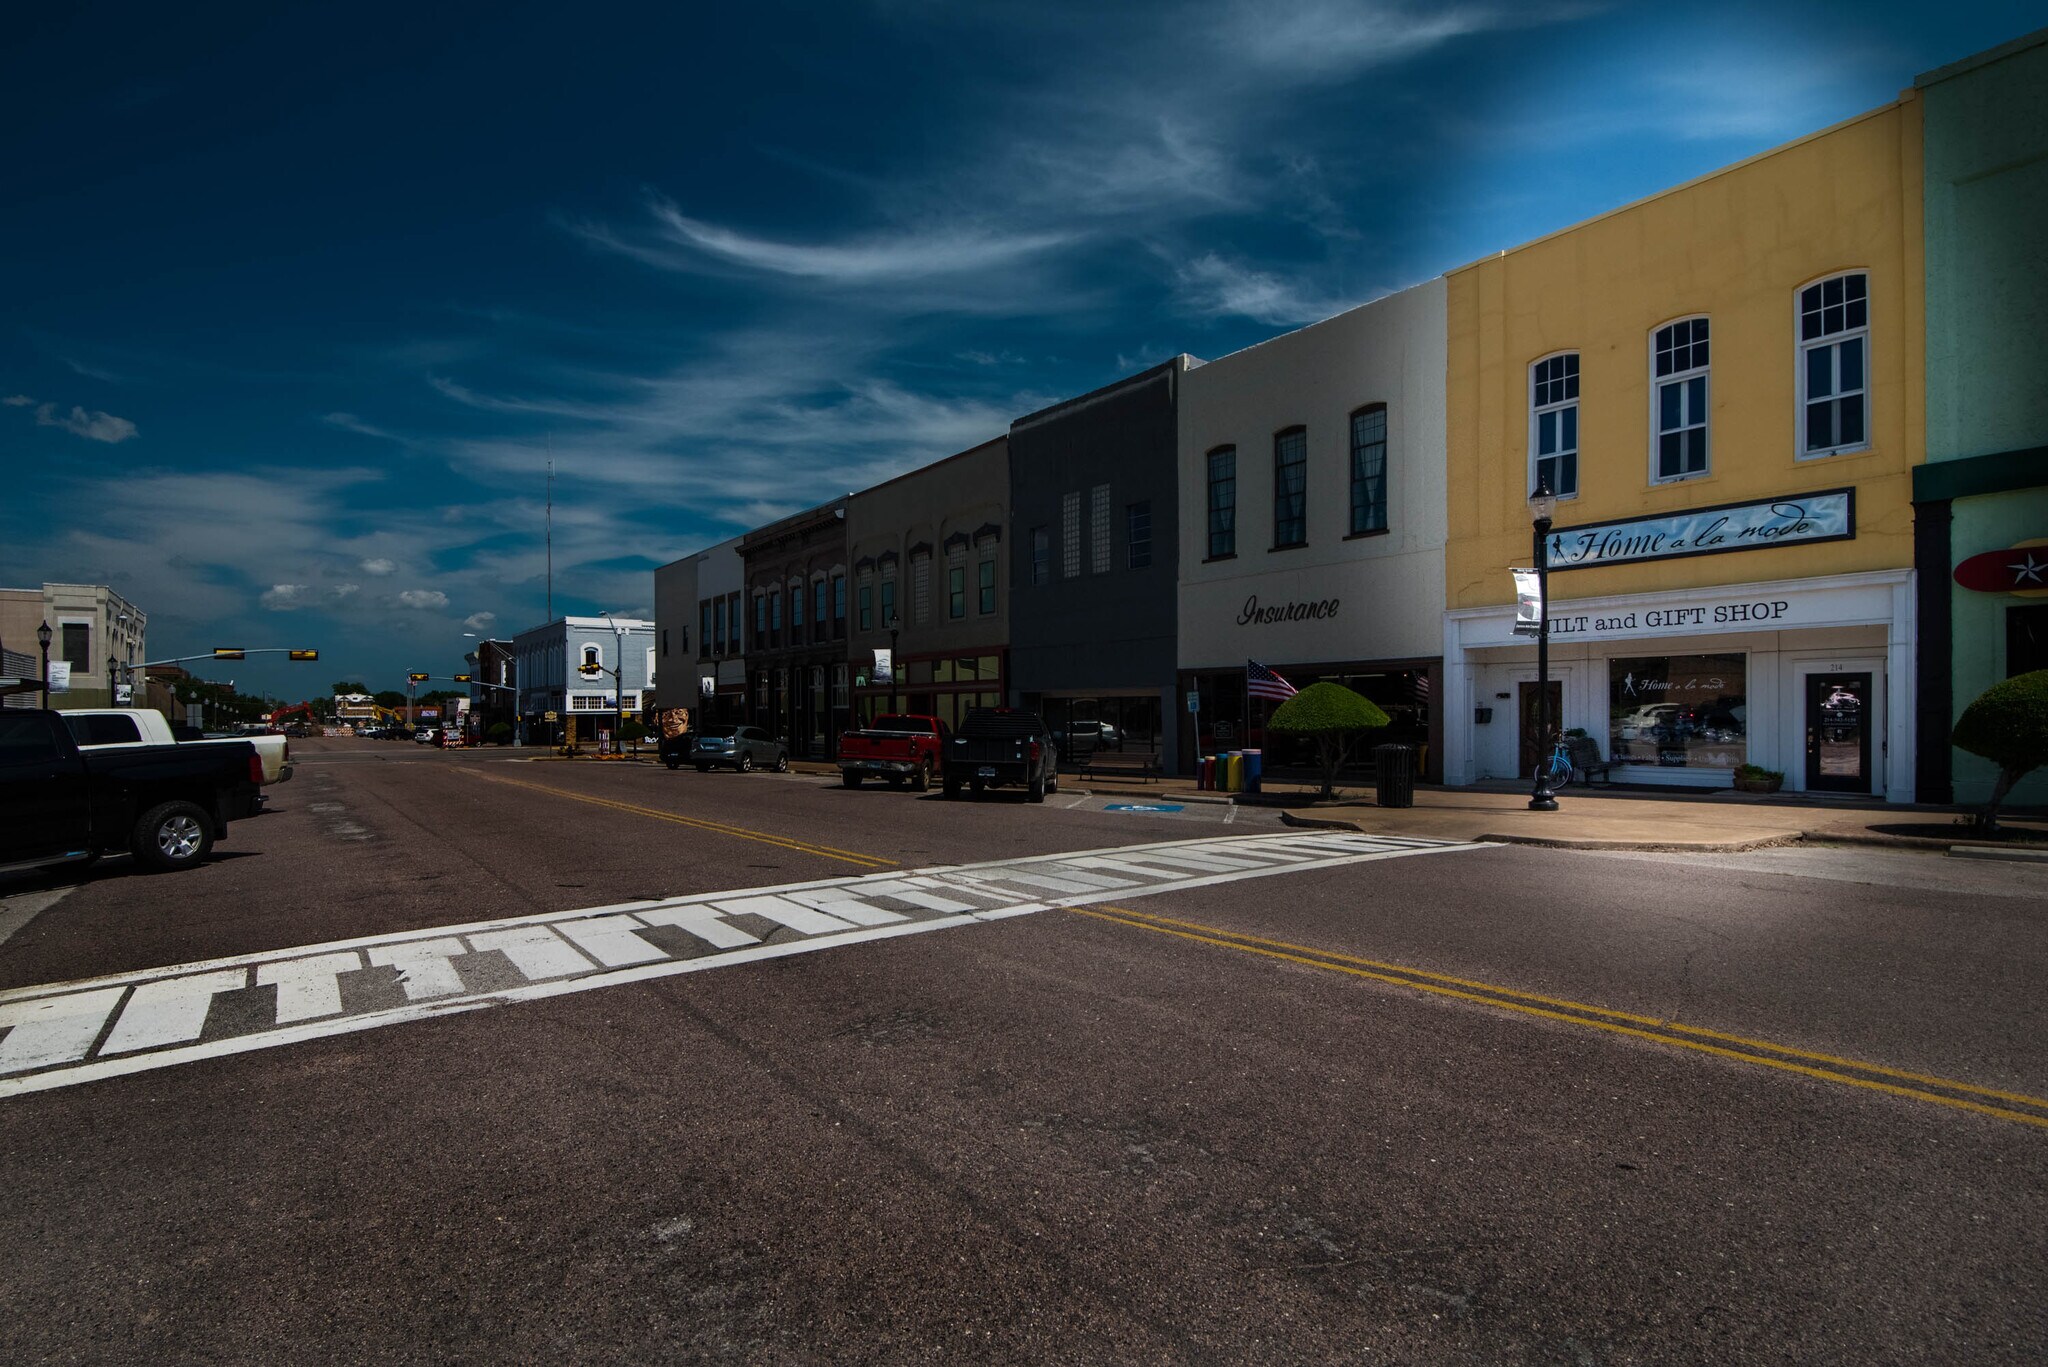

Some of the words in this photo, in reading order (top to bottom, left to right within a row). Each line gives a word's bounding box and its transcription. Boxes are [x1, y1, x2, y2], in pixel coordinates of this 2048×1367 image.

[1571, 529, 1665, 562] Home
[1670, 539, 1684, 549] a
[1693, 517, 1725, 547] la
[1738, 503, 1820, 538] mode
[1237, 594, 1340, 625] Insurance
[1595, 613, 1636, 631] and
[1645, 607, 1706, 628] GIFT
[1714, 601, 1788, 624] SHOP
[1639, 679, 1673, 691] Home
[1700, 677, 1727, 689] mode
